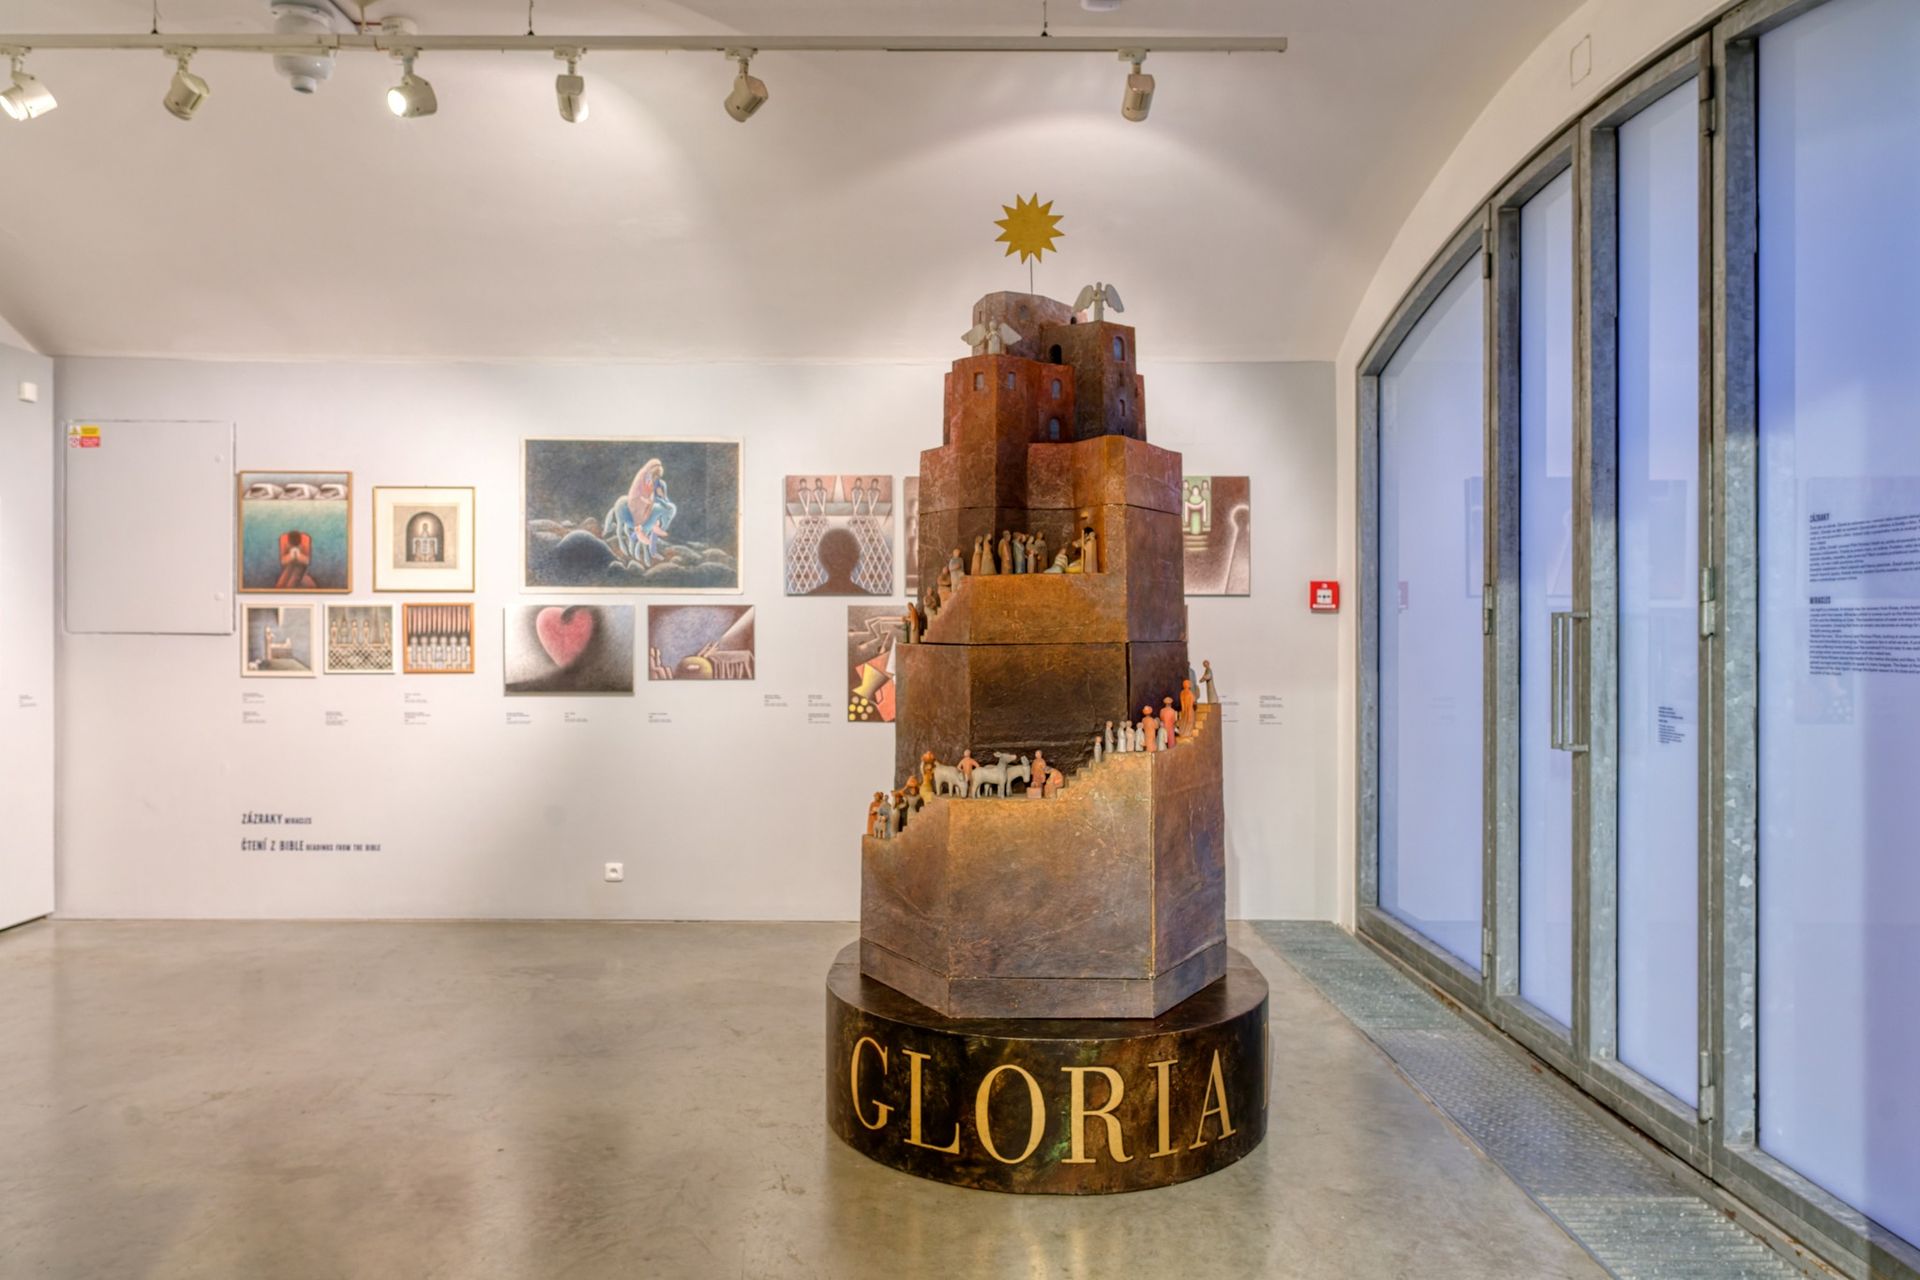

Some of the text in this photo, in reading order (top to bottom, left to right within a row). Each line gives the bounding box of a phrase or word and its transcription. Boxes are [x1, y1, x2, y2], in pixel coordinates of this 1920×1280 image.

[241, 811, 283, 825] ZÁZRAKY
[240, 837, 268, 851] ČTENÍ
[270, 840, 276, 851] Z
[279, 840, 304, 851] BIBLE
[849, 1036, 1237, 1165] GLORIA
